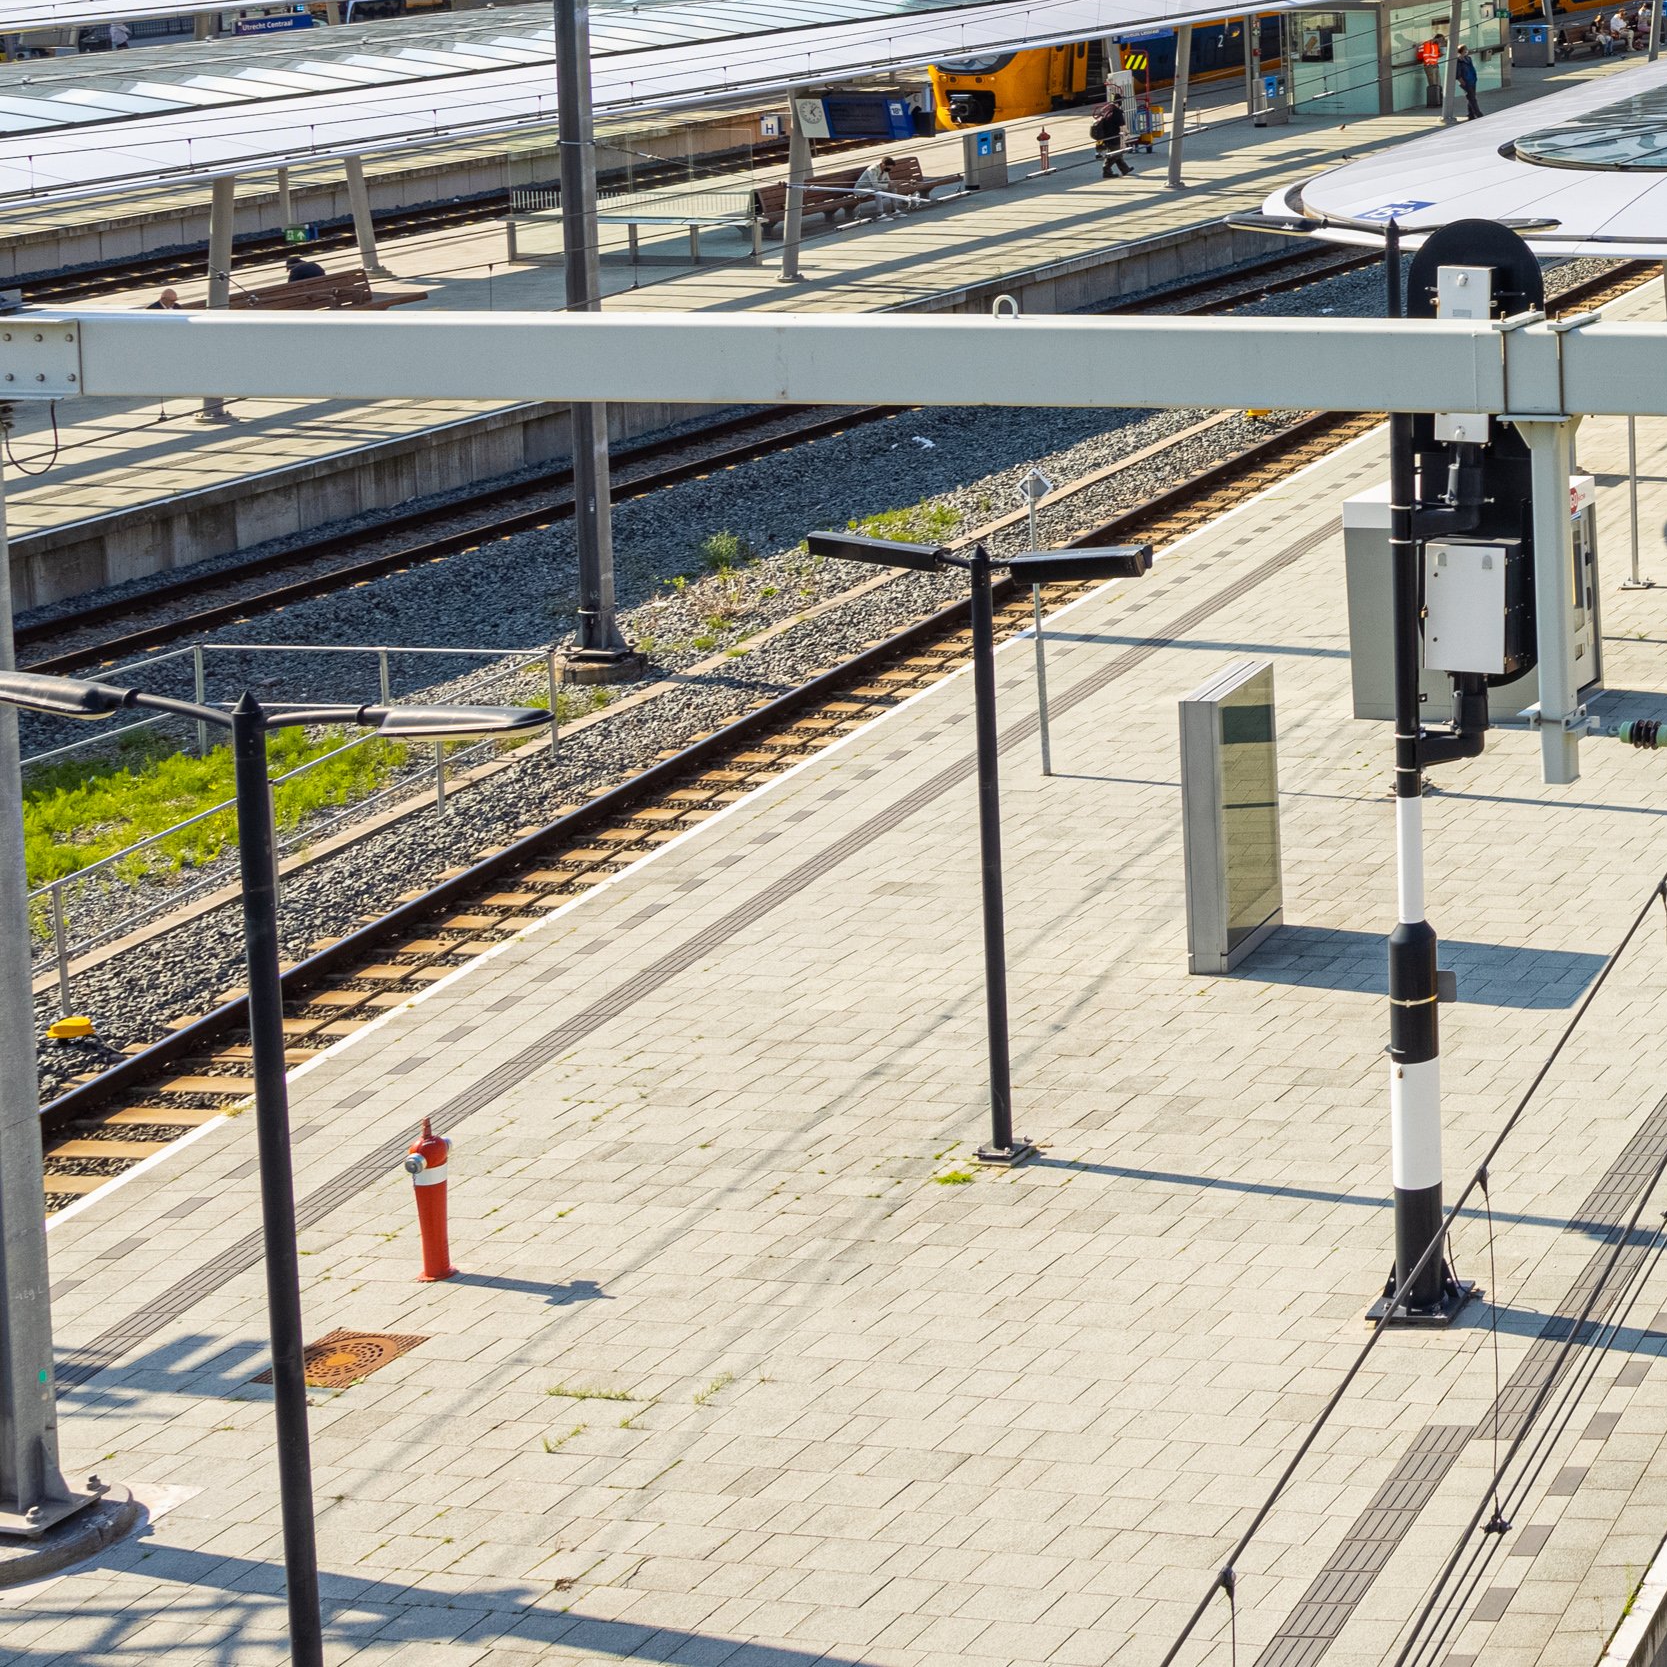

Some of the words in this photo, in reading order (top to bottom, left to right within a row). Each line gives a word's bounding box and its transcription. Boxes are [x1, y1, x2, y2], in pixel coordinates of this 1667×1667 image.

[242, 22, 266, 31] Utrecht
[266, 19, 294, 29] Centraal
[1217, 34, 1224, 48] 2
[765, 123, 775, 135] H
